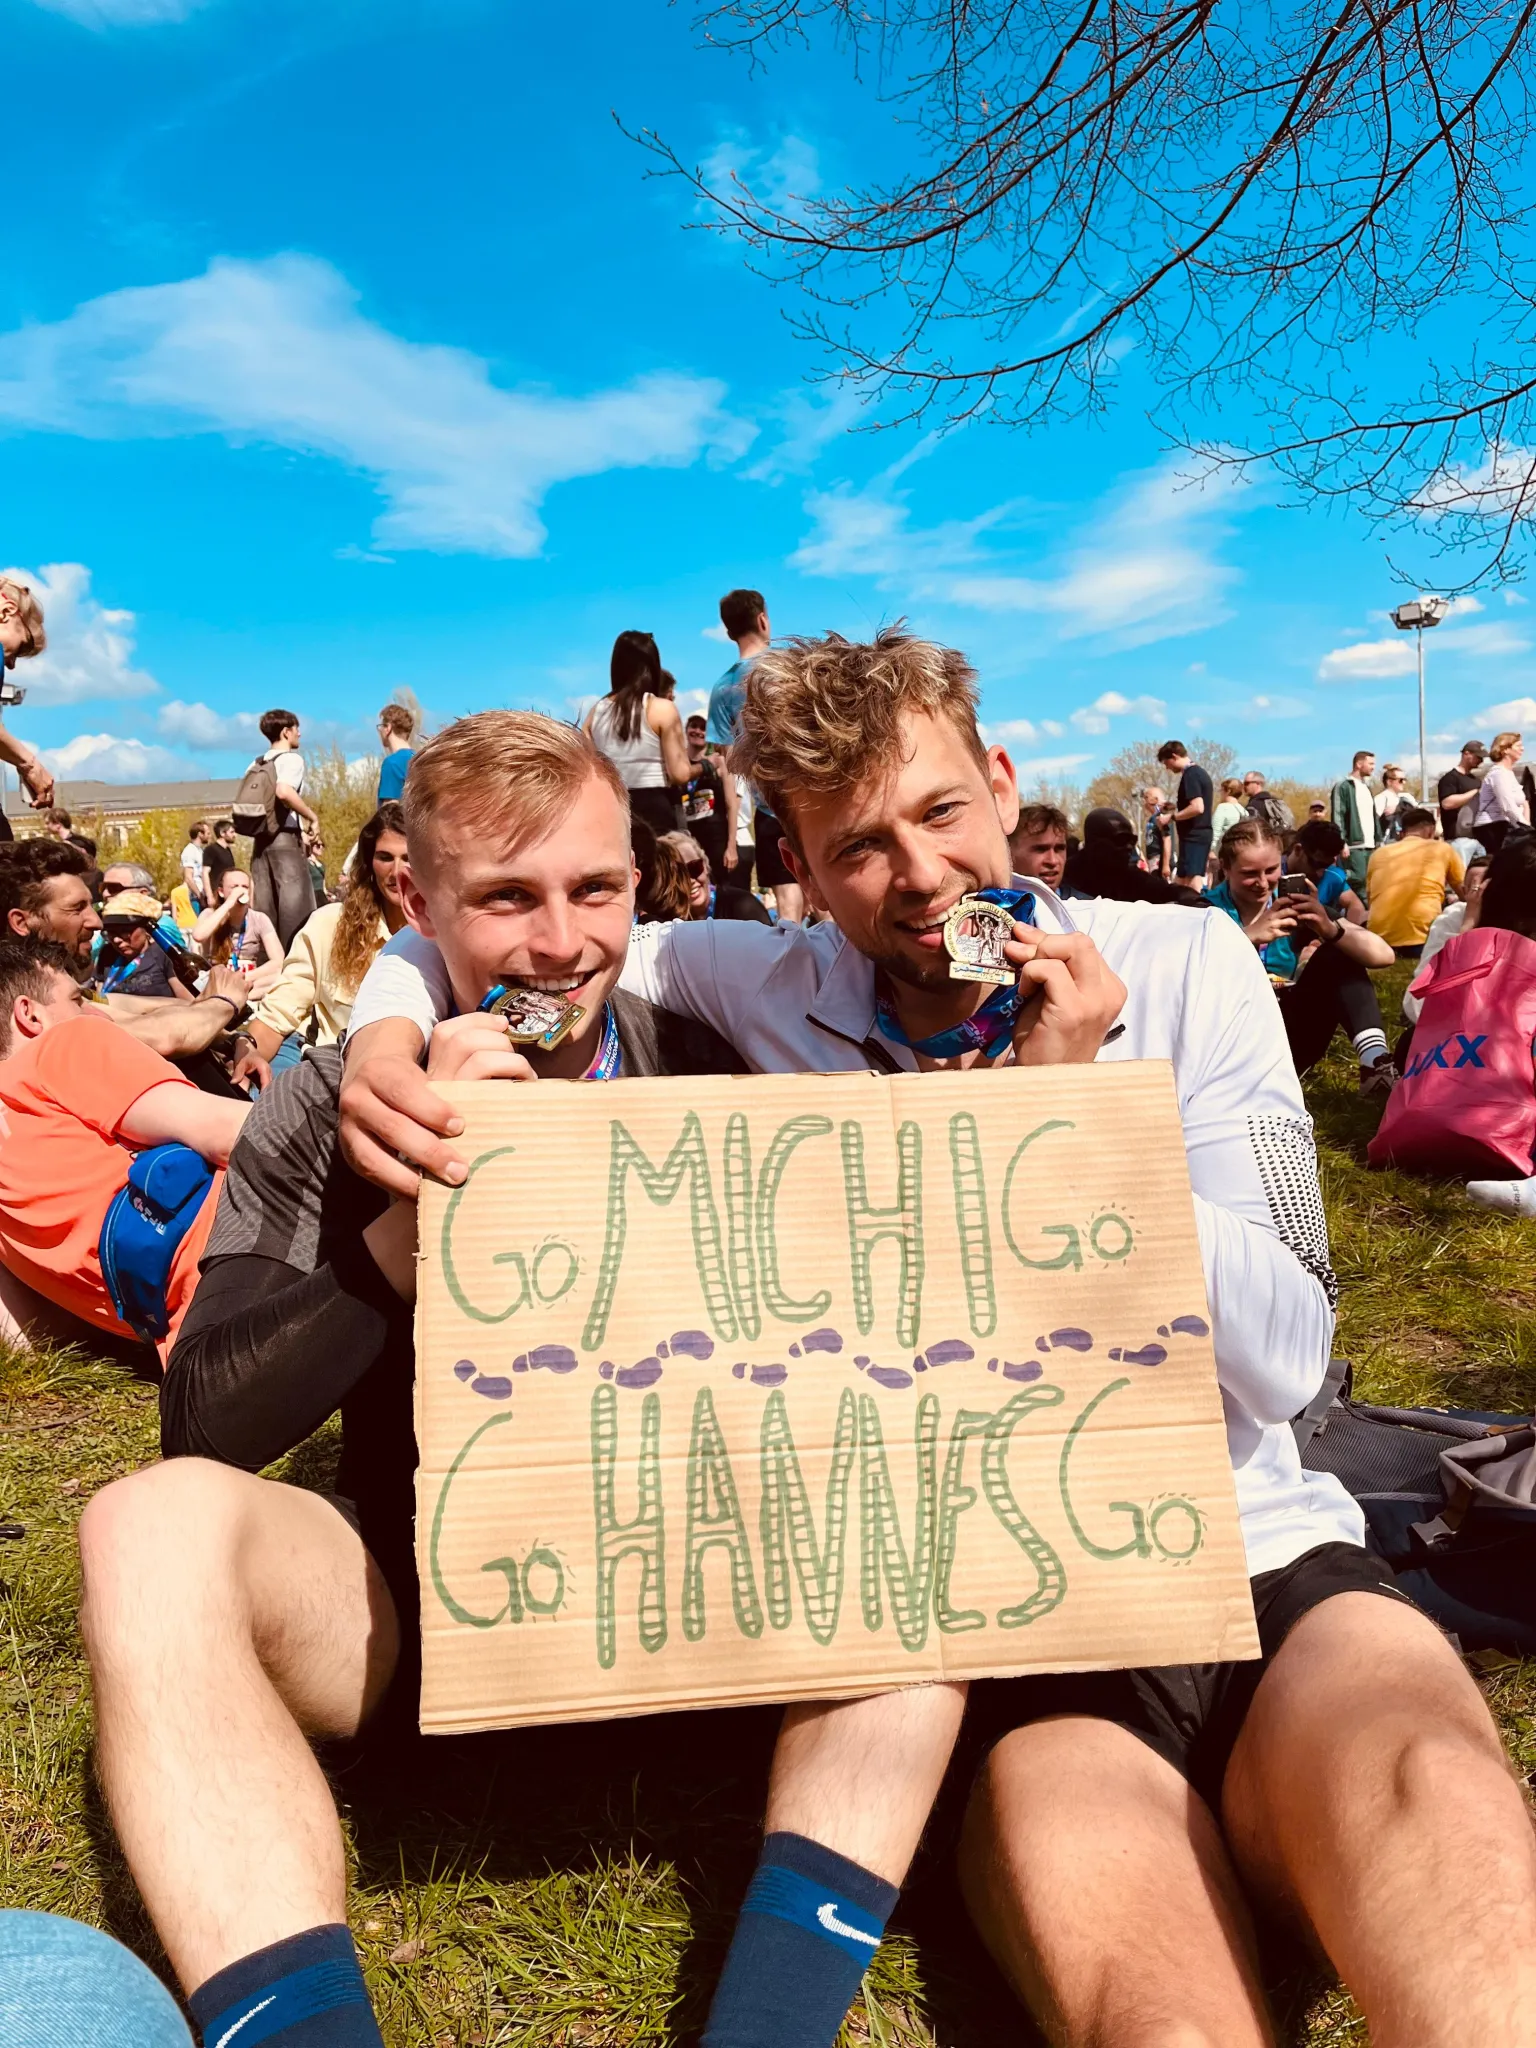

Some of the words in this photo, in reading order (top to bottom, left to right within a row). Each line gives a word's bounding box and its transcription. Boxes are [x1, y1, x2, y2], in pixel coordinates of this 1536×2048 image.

[605, 1031, 616, 1059] LEIPZIG
[1000, 994, 1025, 1018] 025
[581, 1111, 997, 1352] MICHI
[592, 1384, 1067, 1668] HANNES
